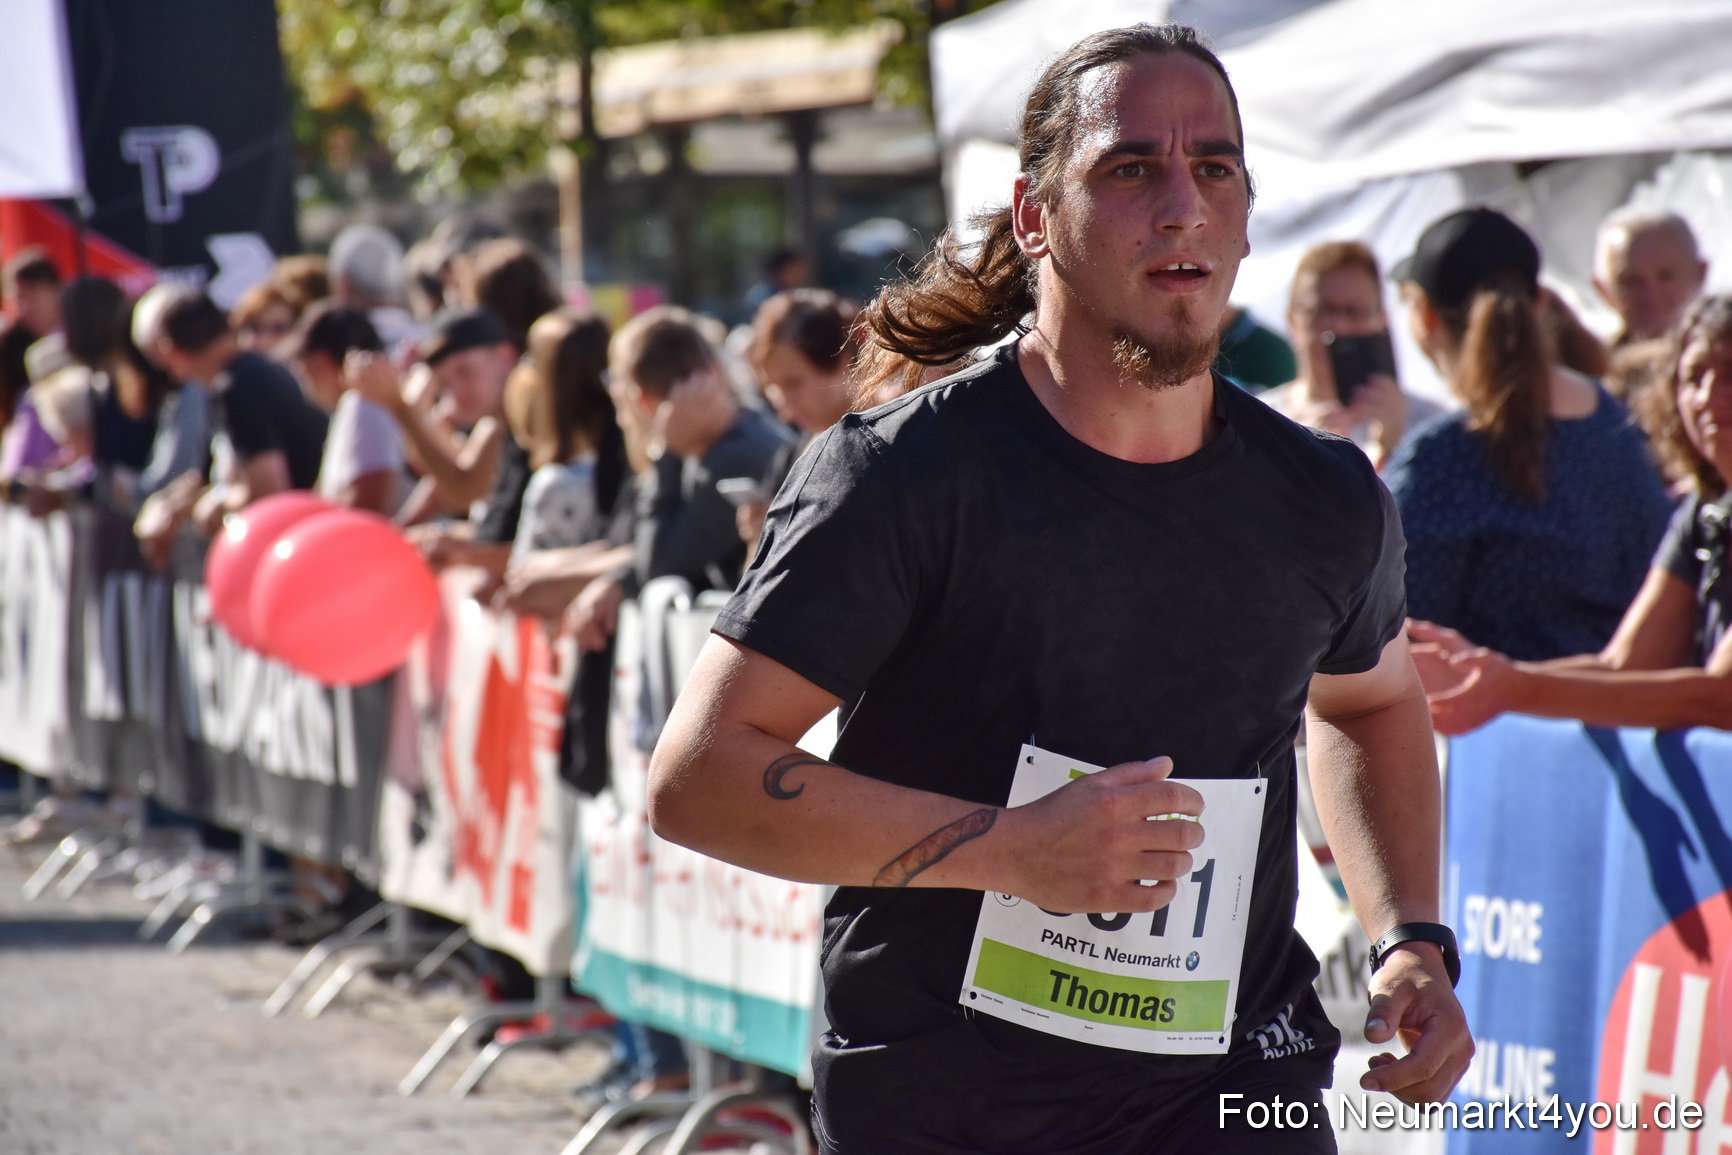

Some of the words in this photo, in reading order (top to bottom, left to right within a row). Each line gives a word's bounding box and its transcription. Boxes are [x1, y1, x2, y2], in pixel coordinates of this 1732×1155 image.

[1040, 928, 1100, 959] PARTL
[1103, 946, 1182, 969] Neumarkt
[1463, 894, 1543, 964] STORE
[1050, 969, 1177, 1024] Thomas
[1460, 1039, 1555, 1106] NLINE
